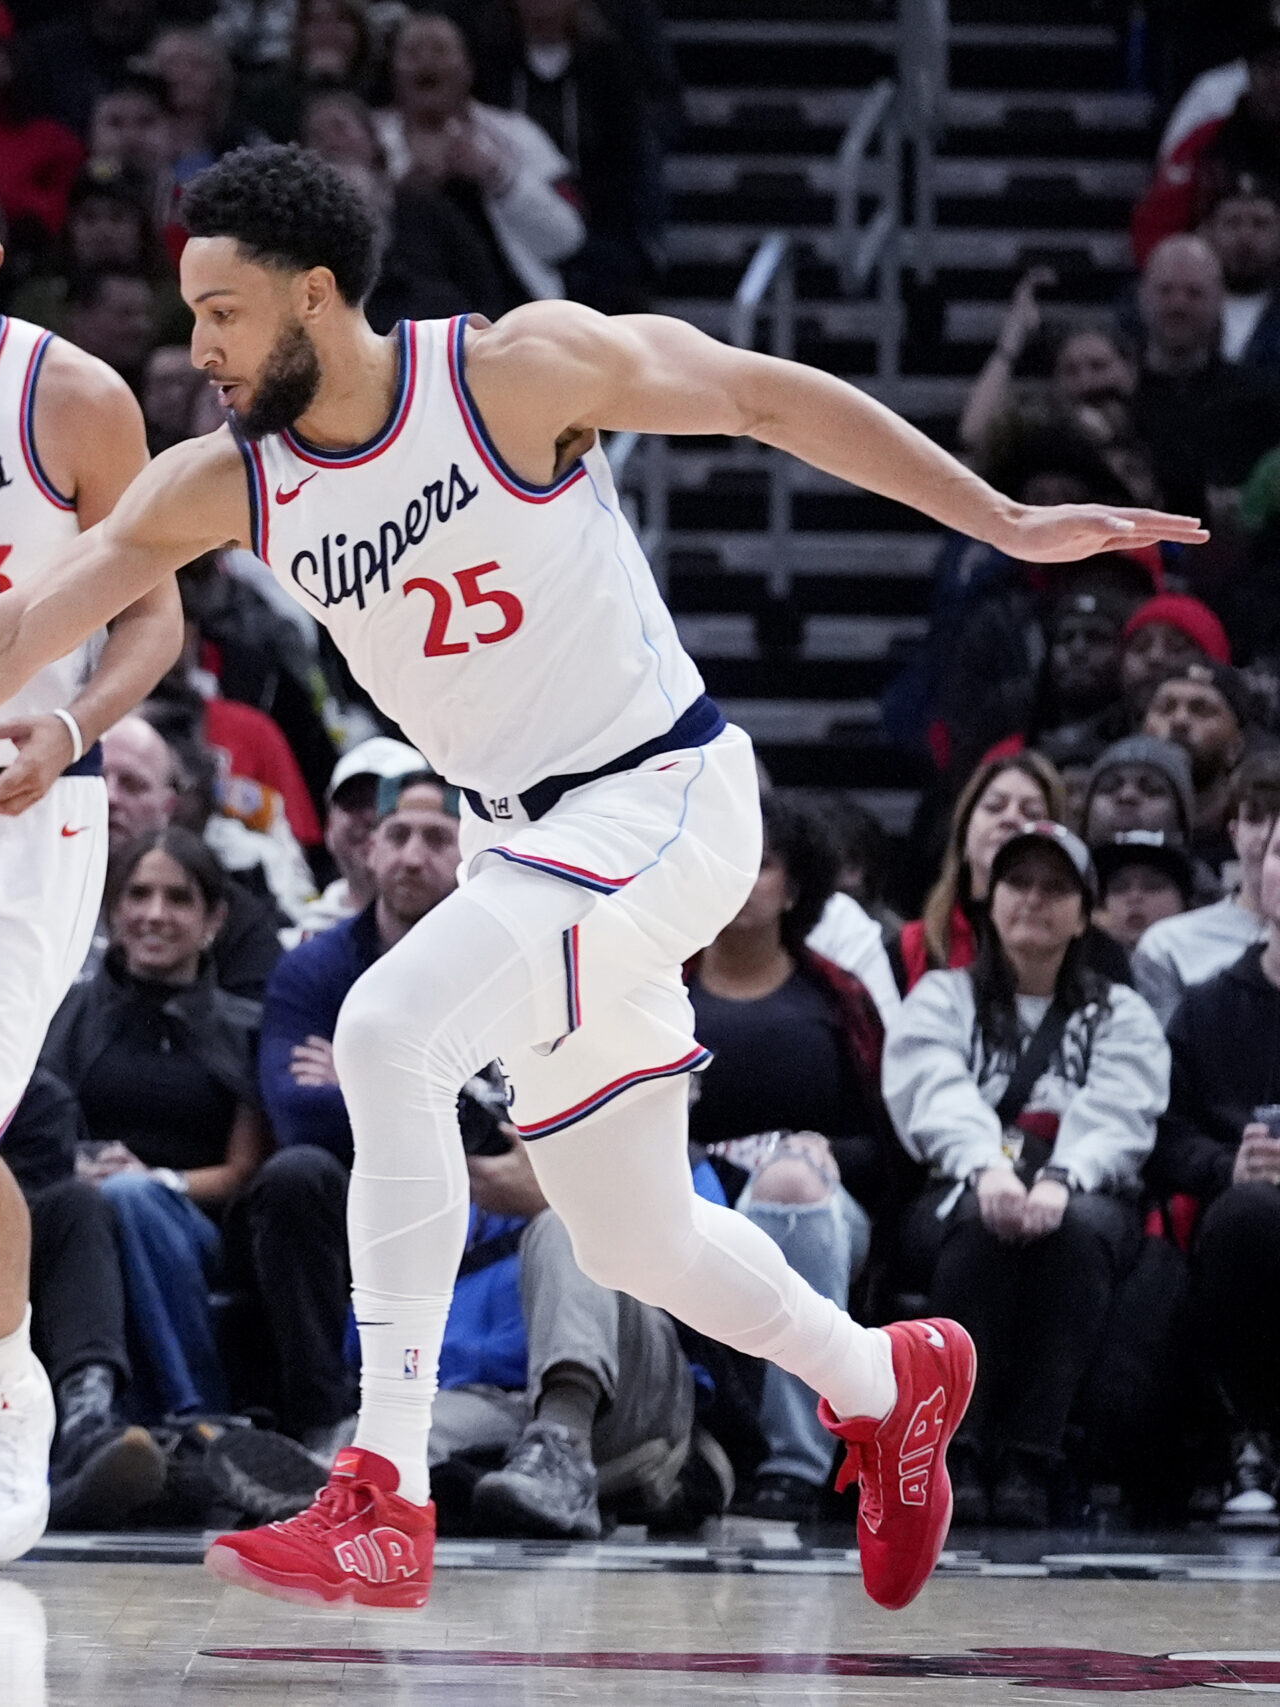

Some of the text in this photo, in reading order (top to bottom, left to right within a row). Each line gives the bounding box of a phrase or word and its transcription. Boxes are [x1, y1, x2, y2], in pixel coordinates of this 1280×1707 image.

[291, 463, 479, 610] Clippers
[402, 560, 524, 658] 25
[899, 1385, 946, 1506] AIR
[334, 1526, 420, 1583] AIR
